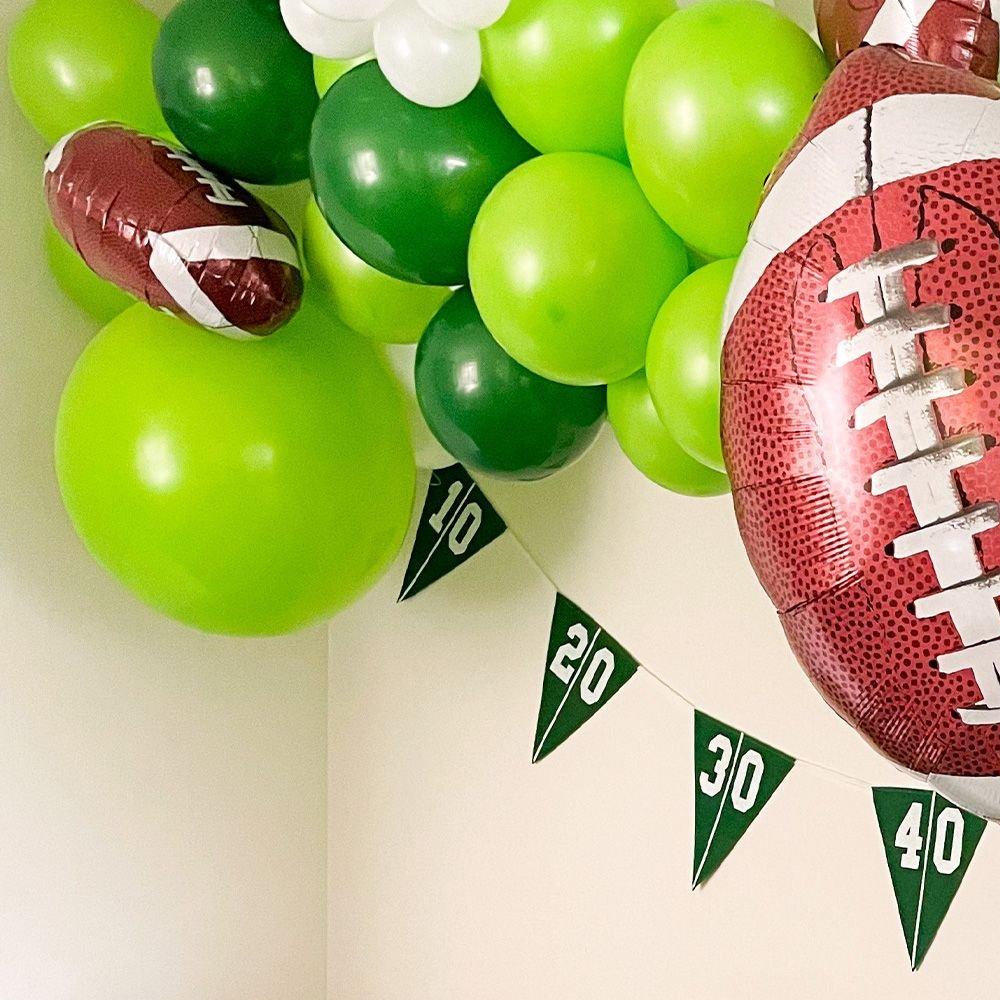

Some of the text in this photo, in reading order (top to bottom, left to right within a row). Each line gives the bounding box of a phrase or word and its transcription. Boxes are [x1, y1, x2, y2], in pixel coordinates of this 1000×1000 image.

[428, 480, 482, 555] 10
[549, 622, 615, 705] 20
[699, 733, 765, 813] 30
[894, 801, 965, 874] 40
